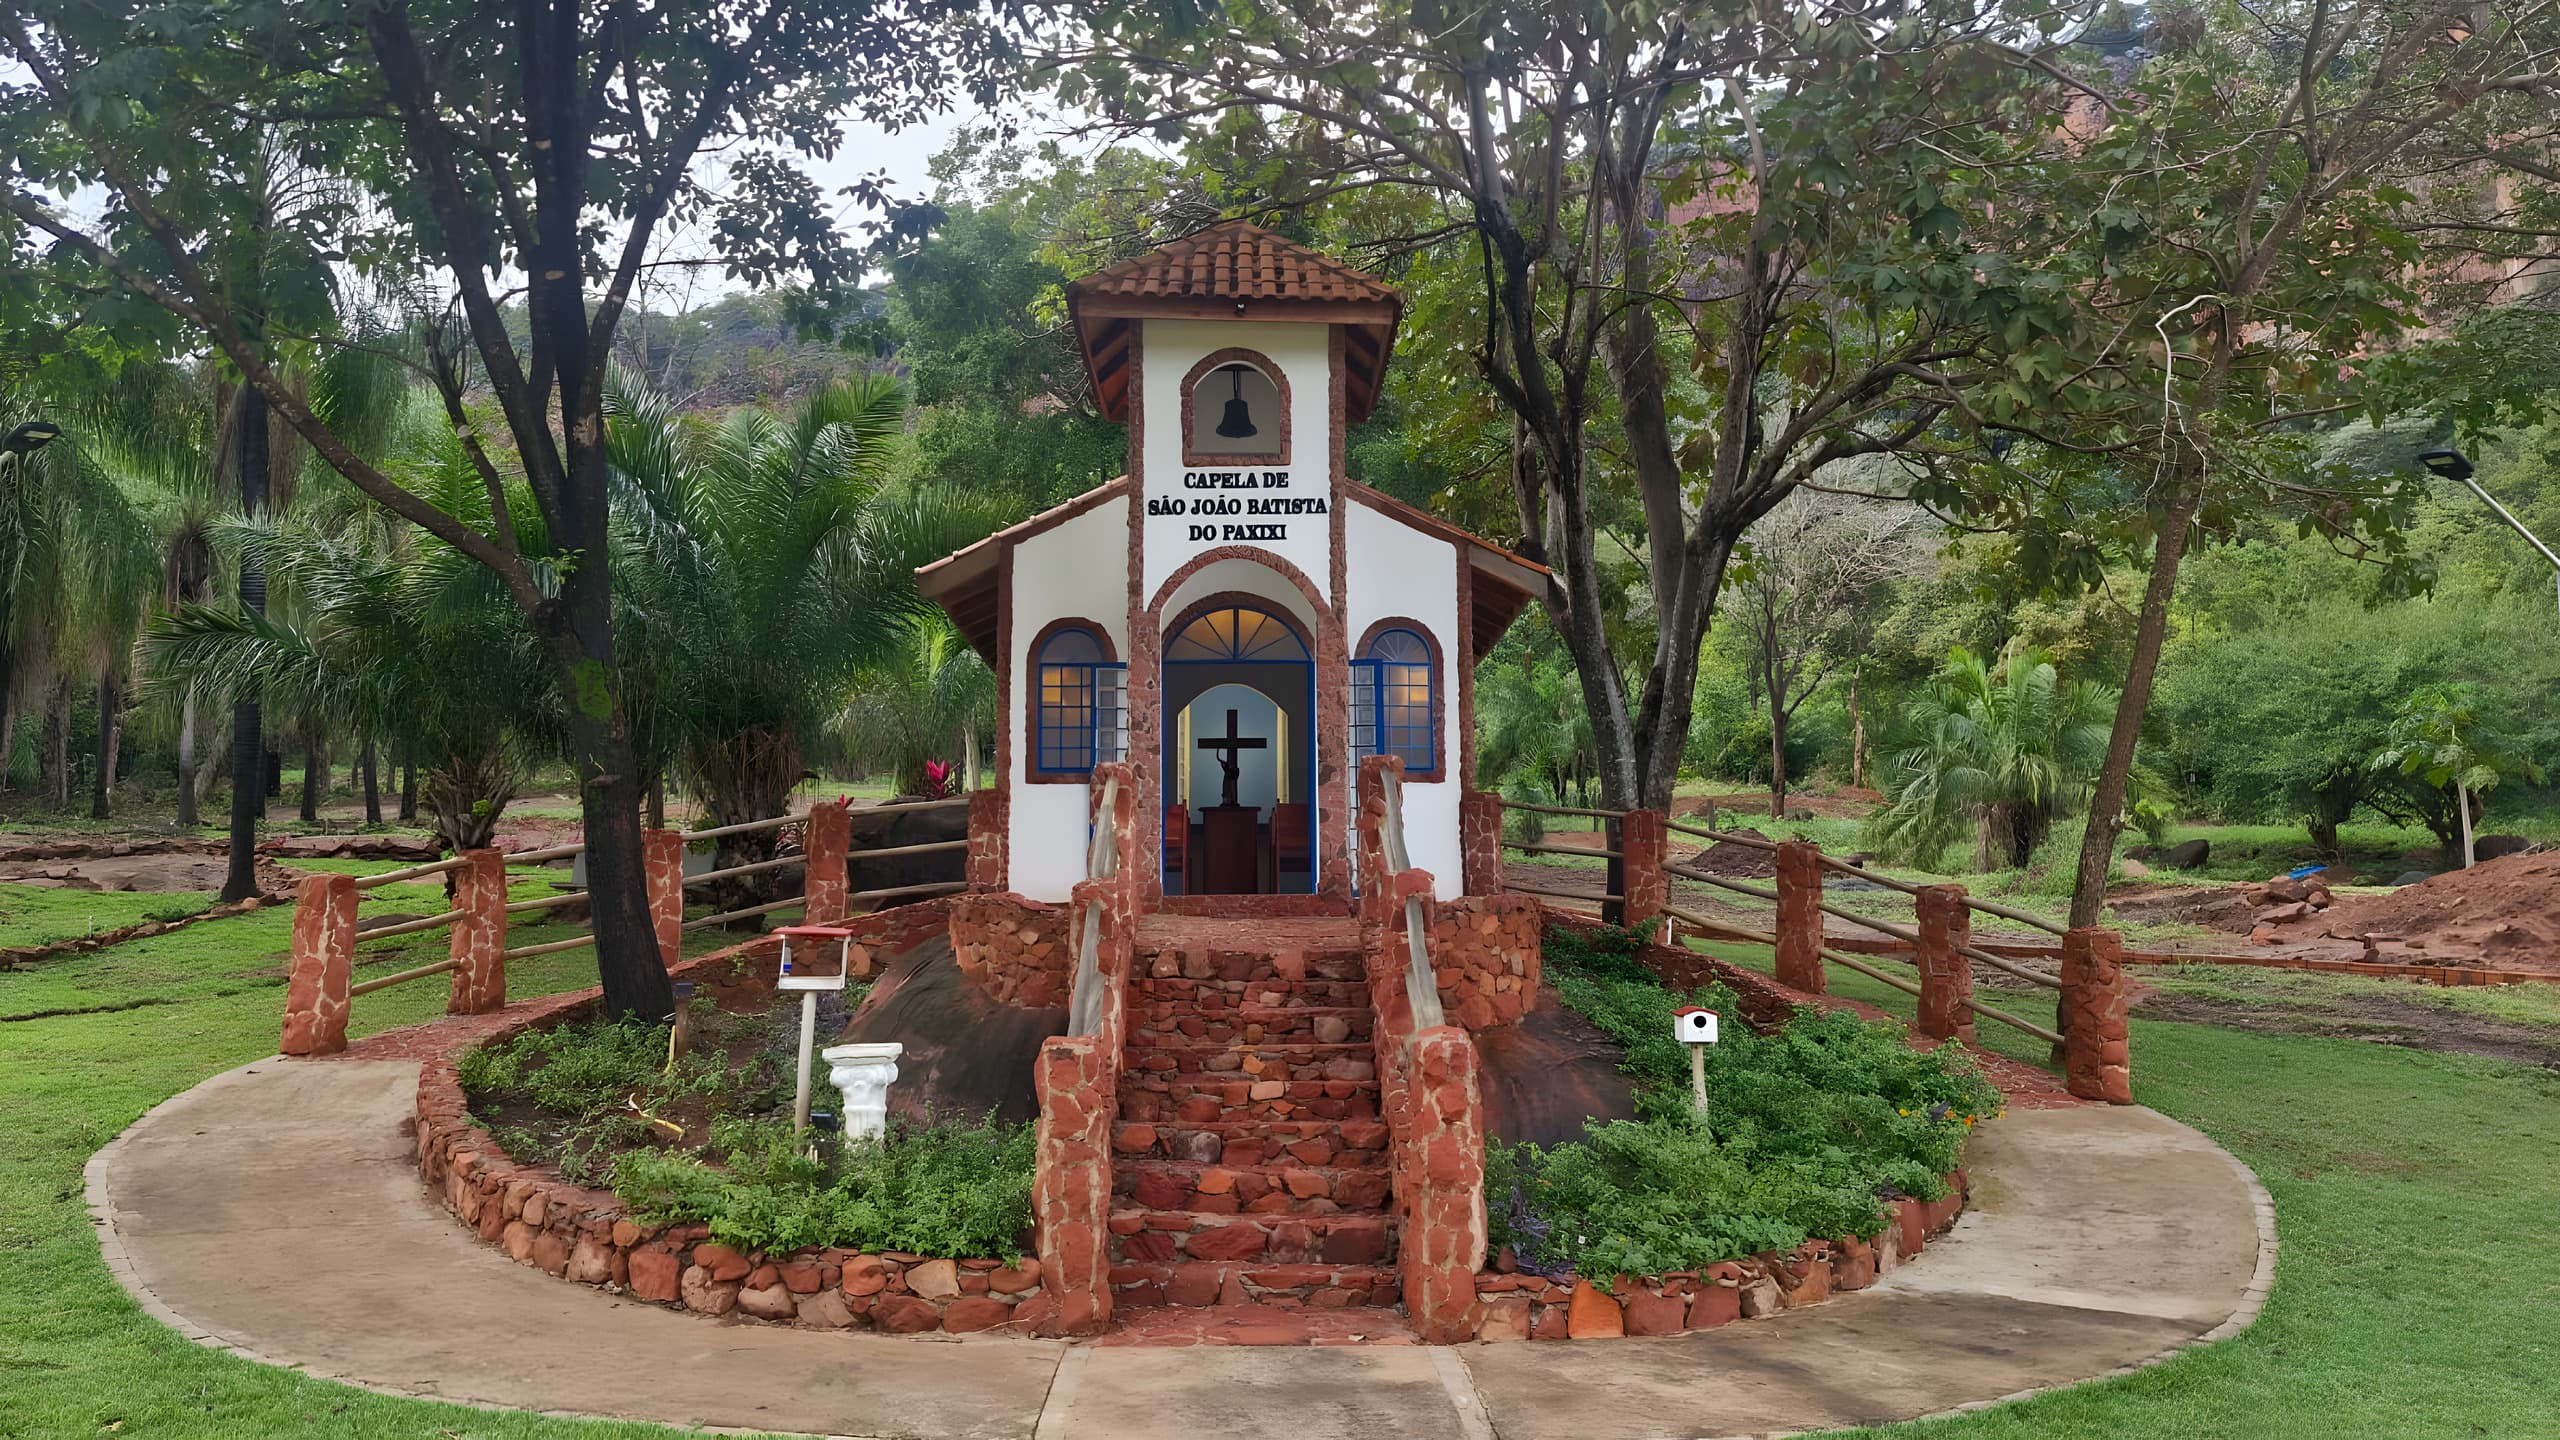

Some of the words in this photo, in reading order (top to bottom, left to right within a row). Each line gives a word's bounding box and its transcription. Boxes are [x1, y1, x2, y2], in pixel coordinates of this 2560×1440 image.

[1184, 472, 1259, 489] CAPELA
[1263, 472, 1289, 488] DE
[1148, 495, 1186, 515] SÃO
[1191, 494, 1242, 515] JOÃO
[1247, 498, 1328, 514] BATISTA
[1189, 525, 1217, 541] DO
[1223, 524, 1287, 540] PAXIXI
